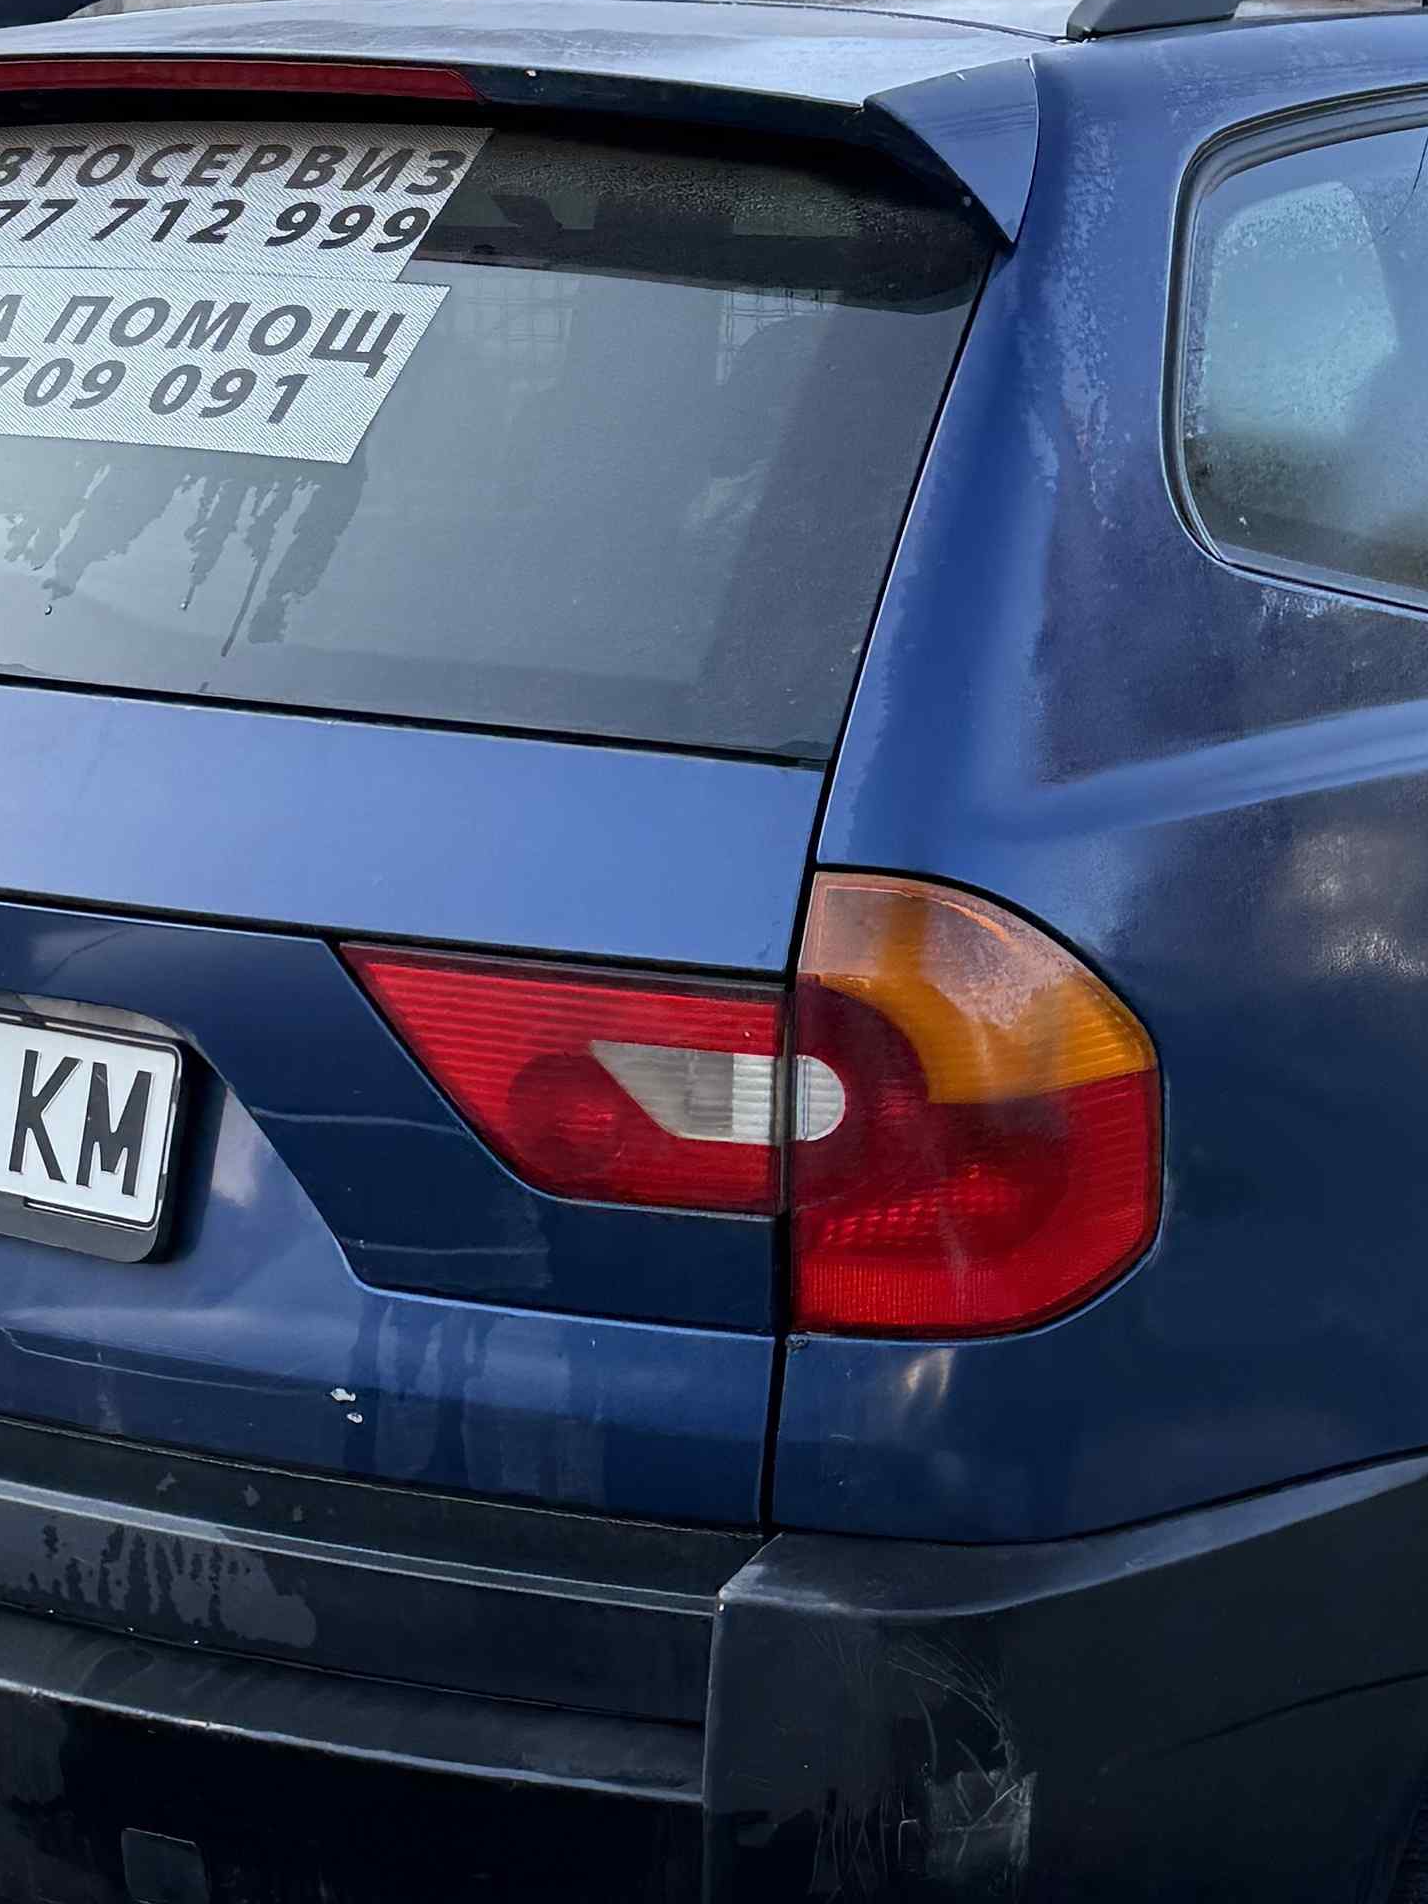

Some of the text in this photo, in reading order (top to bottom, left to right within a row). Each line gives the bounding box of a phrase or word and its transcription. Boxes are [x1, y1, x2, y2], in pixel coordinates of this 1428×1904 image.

[93, 199, 248, 248] 712
[263, 202, 431, 254] 999
[44, 295, 406, 378] ПОМОЩ
[148, 364, 309, 425] 091
